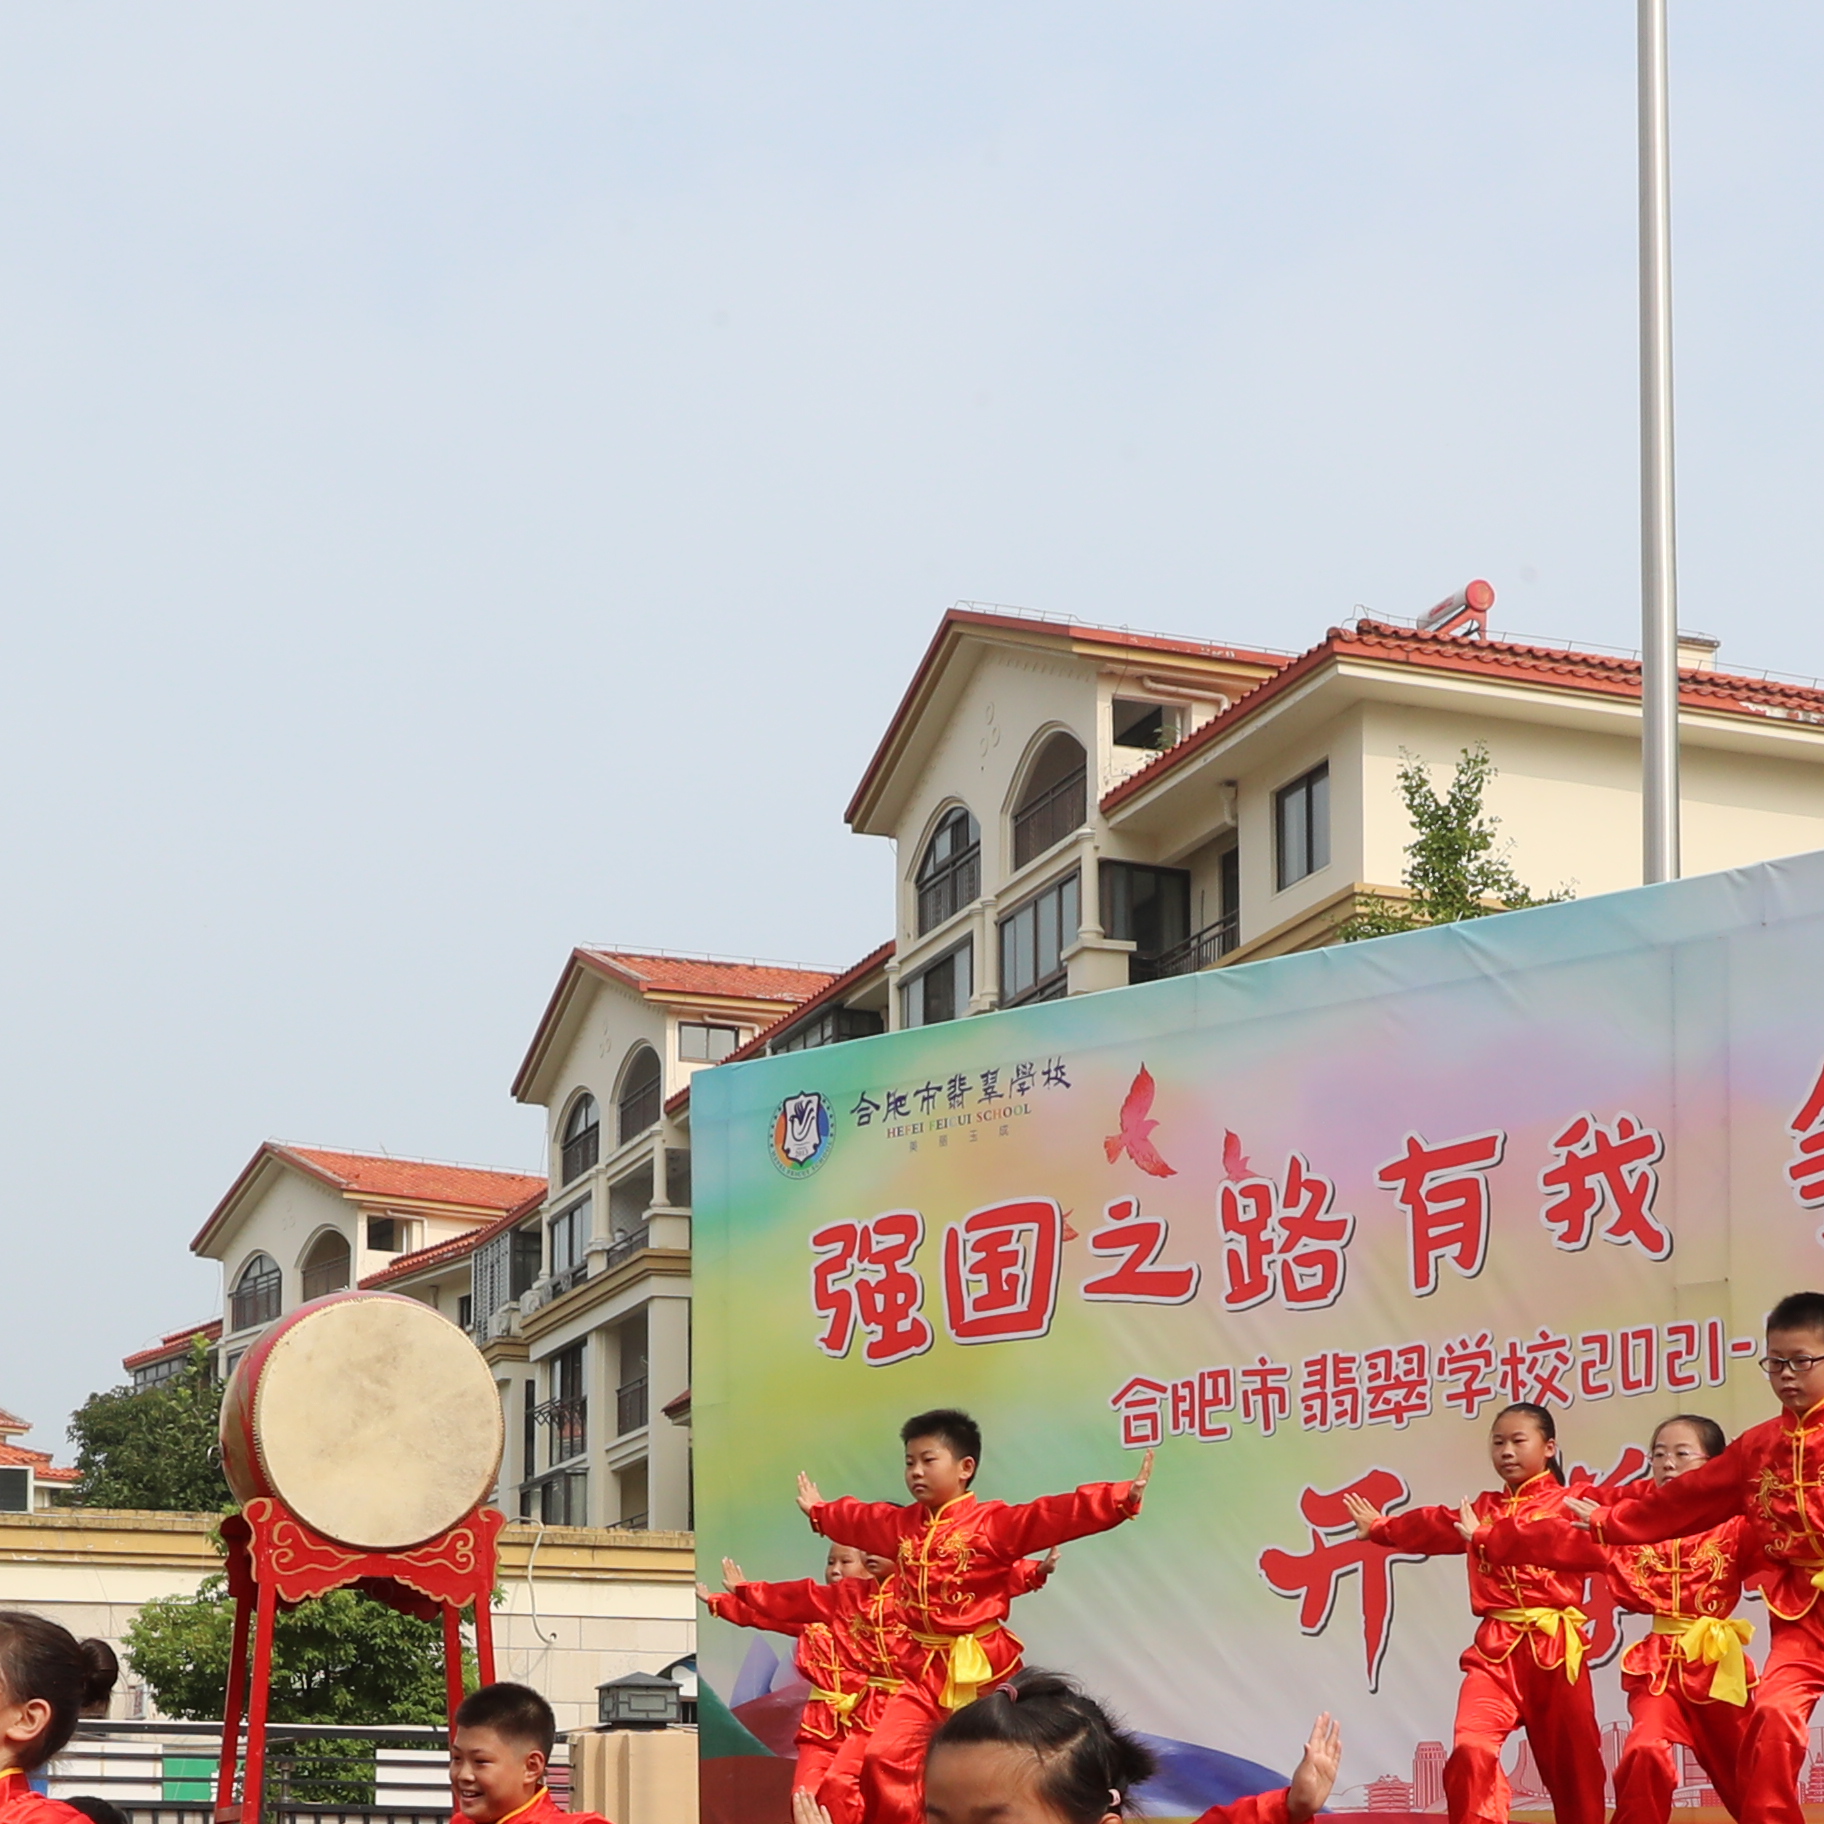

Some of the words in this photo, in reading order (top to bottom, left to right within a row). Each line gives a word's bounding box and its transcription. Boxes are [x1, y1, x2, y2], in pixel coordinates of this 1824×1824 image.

[886, 1121, 925, 1139] HEFEI
[929, 1112, 972, 1132] FEICUI
[976, 1103, 1032, 1123] SCHOOL
[810, 1110, 1673, 1367] 强国之路有我
